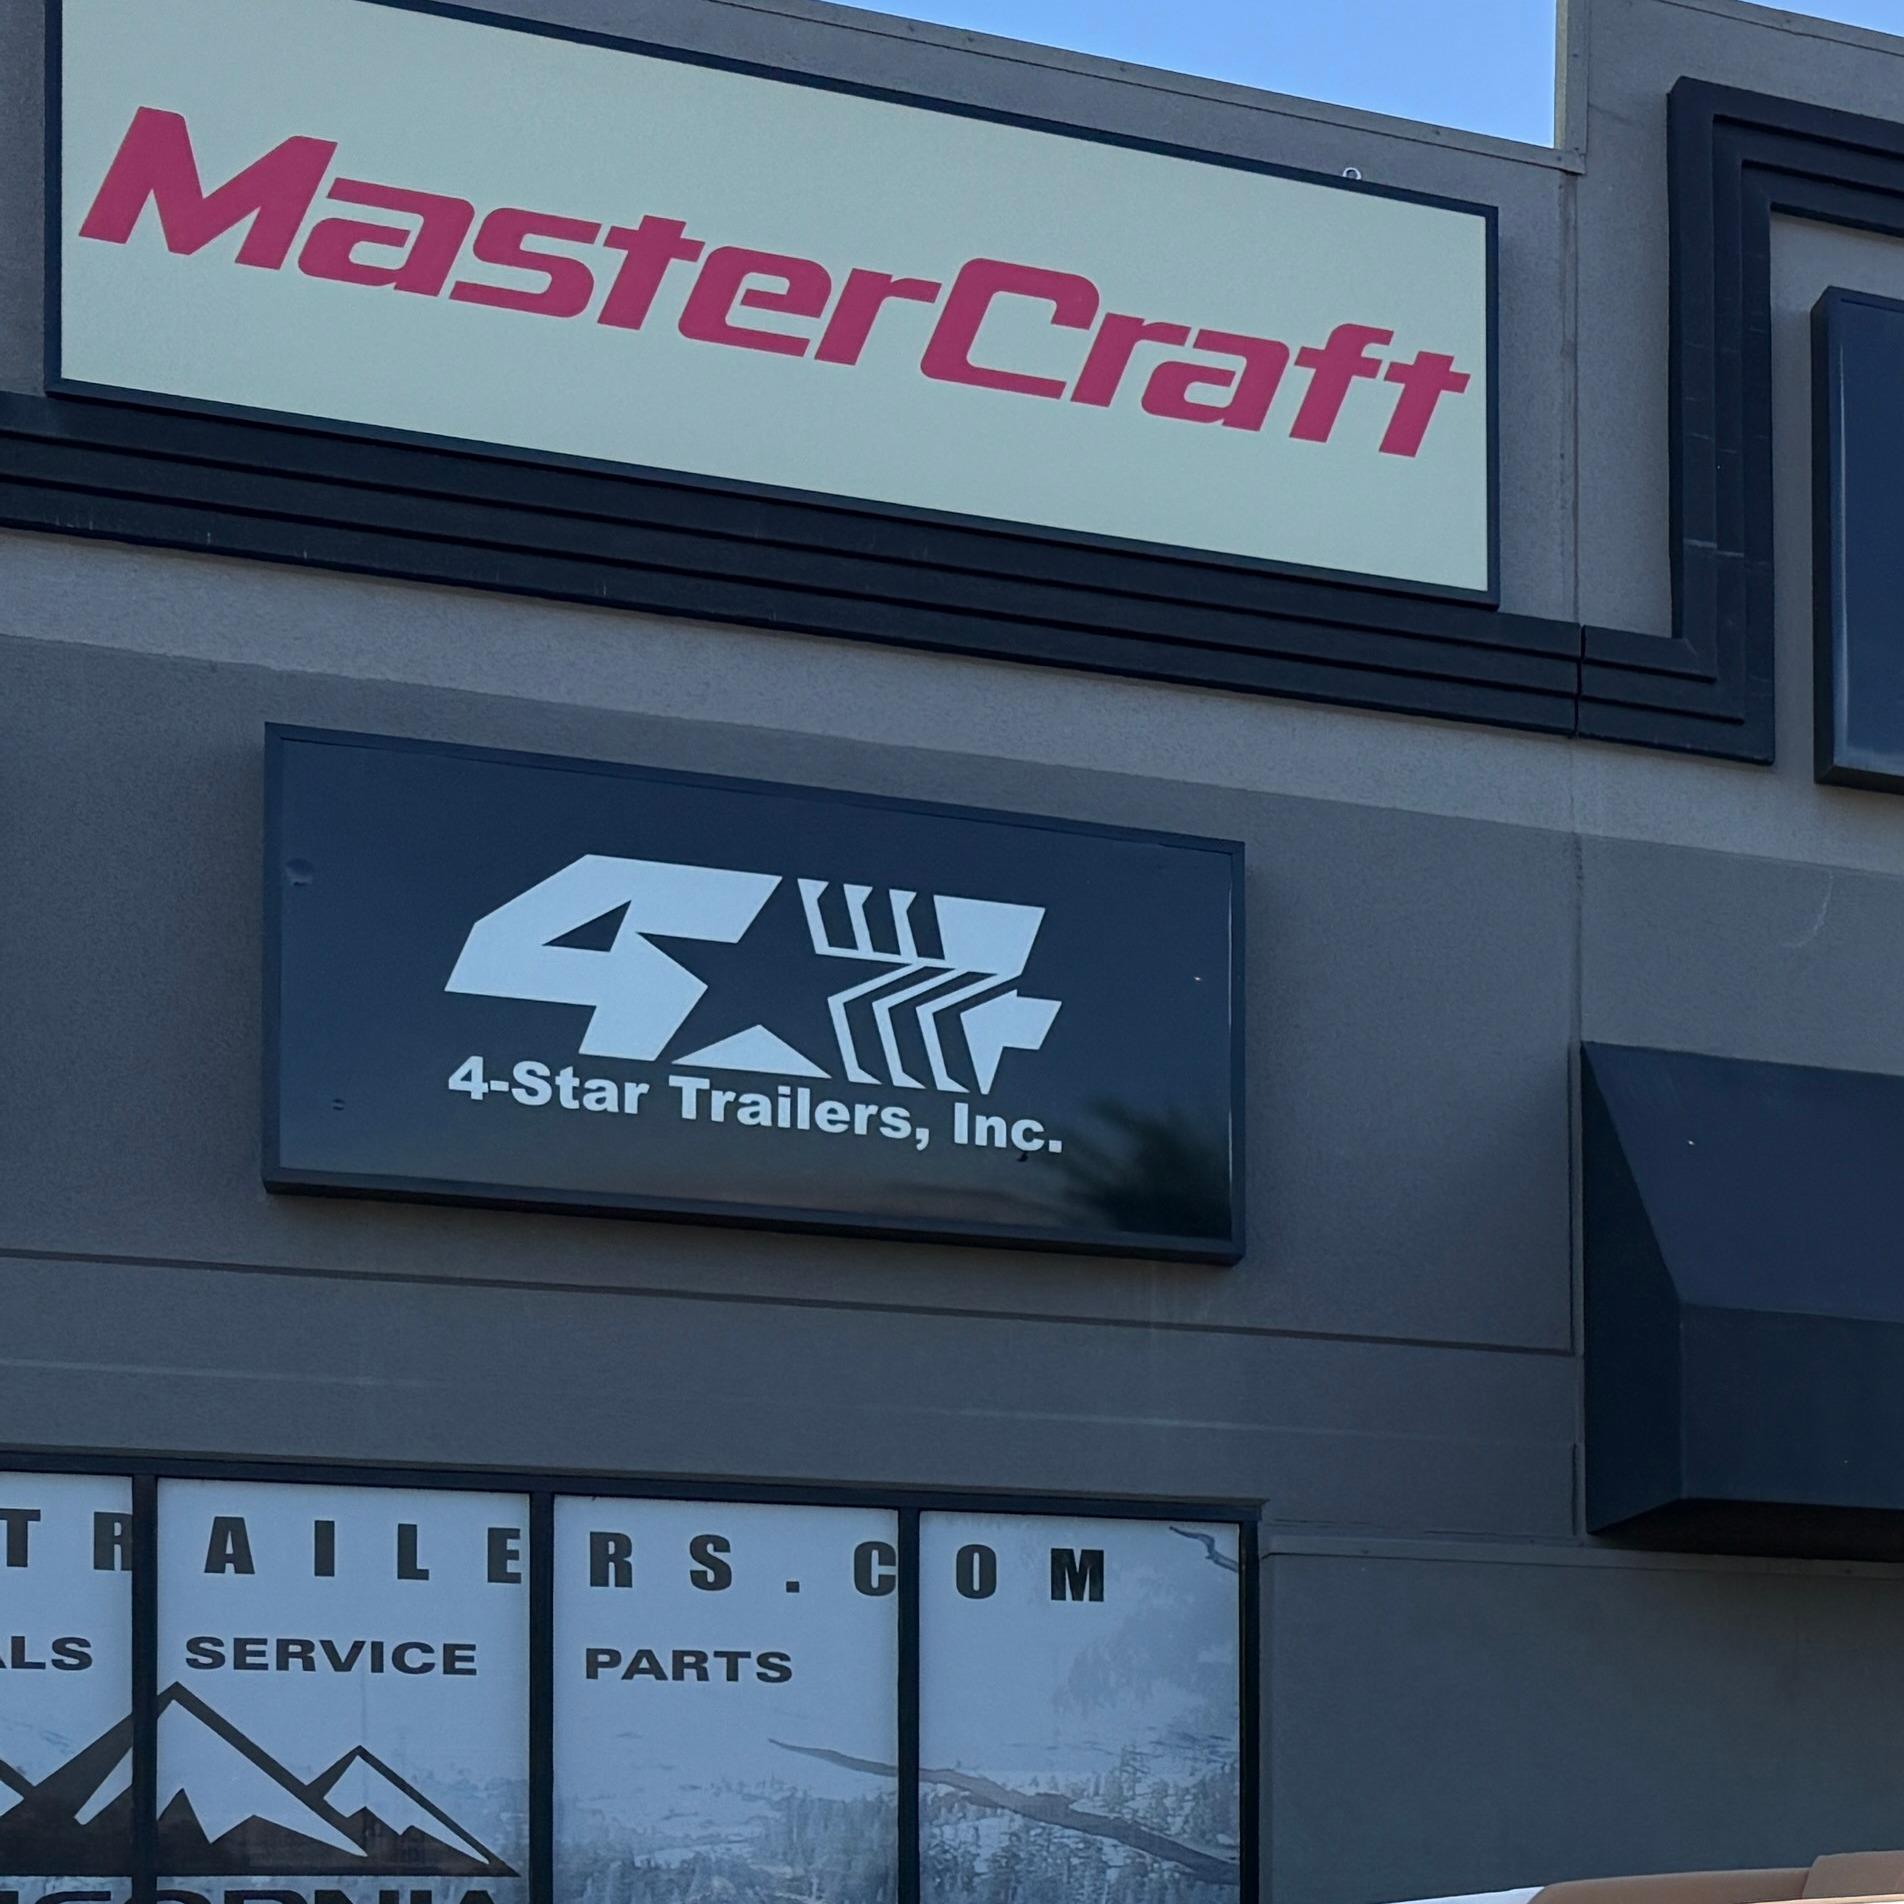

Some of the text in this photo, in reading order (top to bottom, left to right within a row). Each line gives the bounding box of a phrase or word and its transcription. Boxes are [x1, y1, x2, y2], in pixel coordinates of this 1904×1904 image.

[78, 106, 1470, 458] MasterCraft
[447, 1057, 1063, 1154] 4-Star Trailers, Inc.
[0, 1636, 93, 1671] LS
[185, 1636, 478, 1676] SERVICE
[585, 1648, 793, 1683] PARTS
